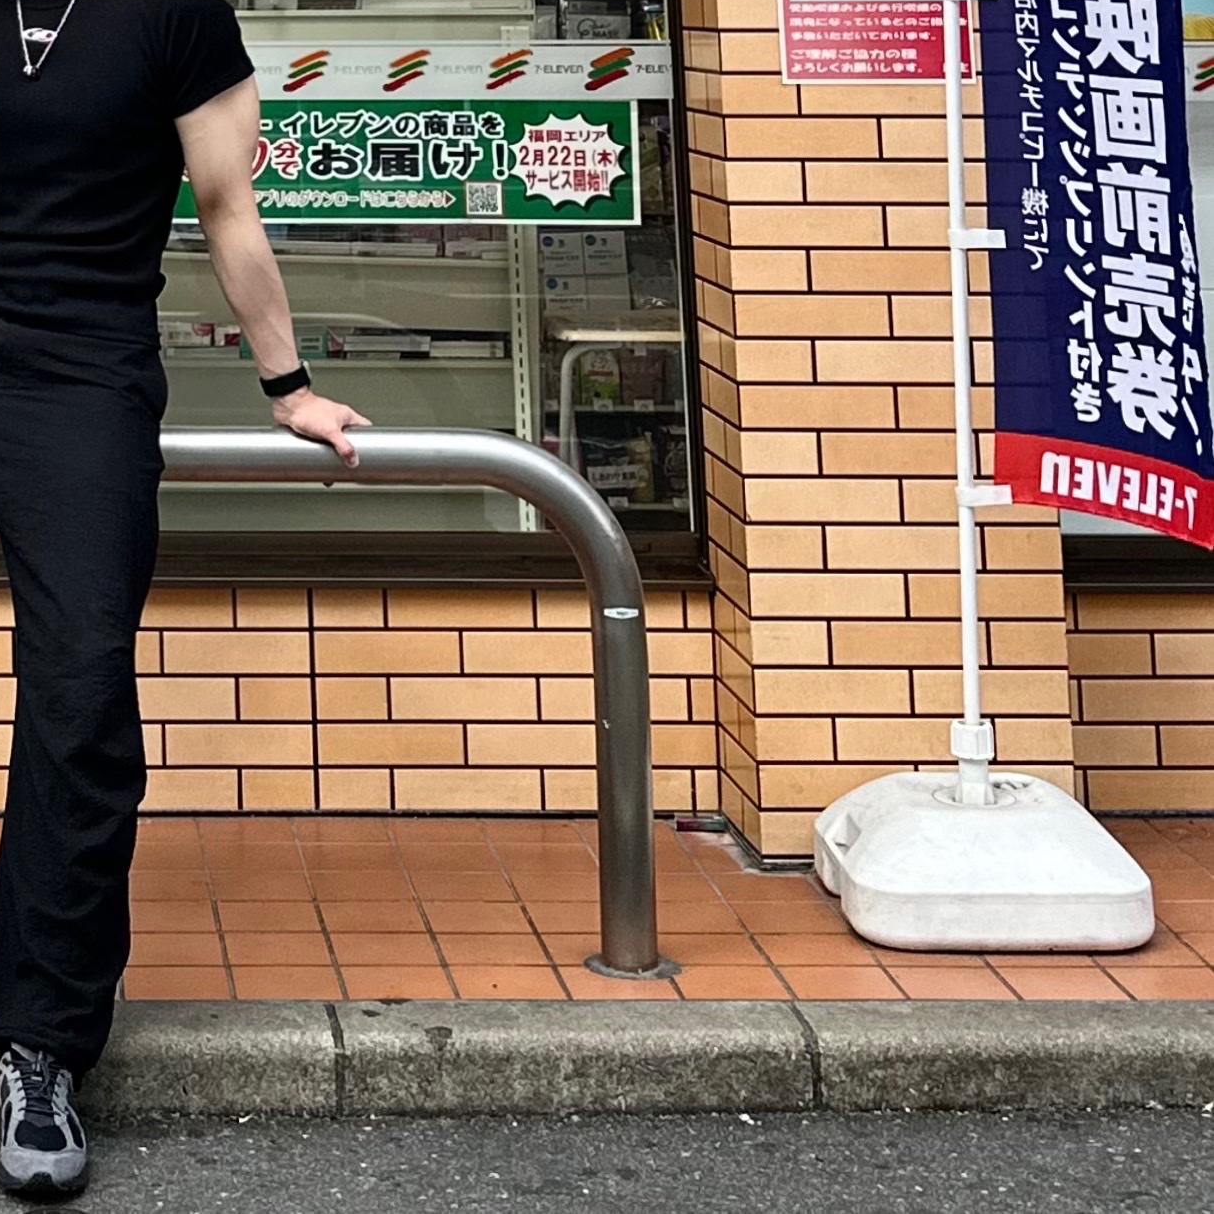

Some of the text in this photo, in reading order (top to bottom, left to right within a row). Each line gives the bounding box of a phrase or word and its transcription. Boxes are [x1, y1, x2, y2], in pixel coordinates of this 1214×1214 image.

[790, 62, 923, 73] よろしくお願いします。
[528, 128, 606, 143] 福岡エリア
